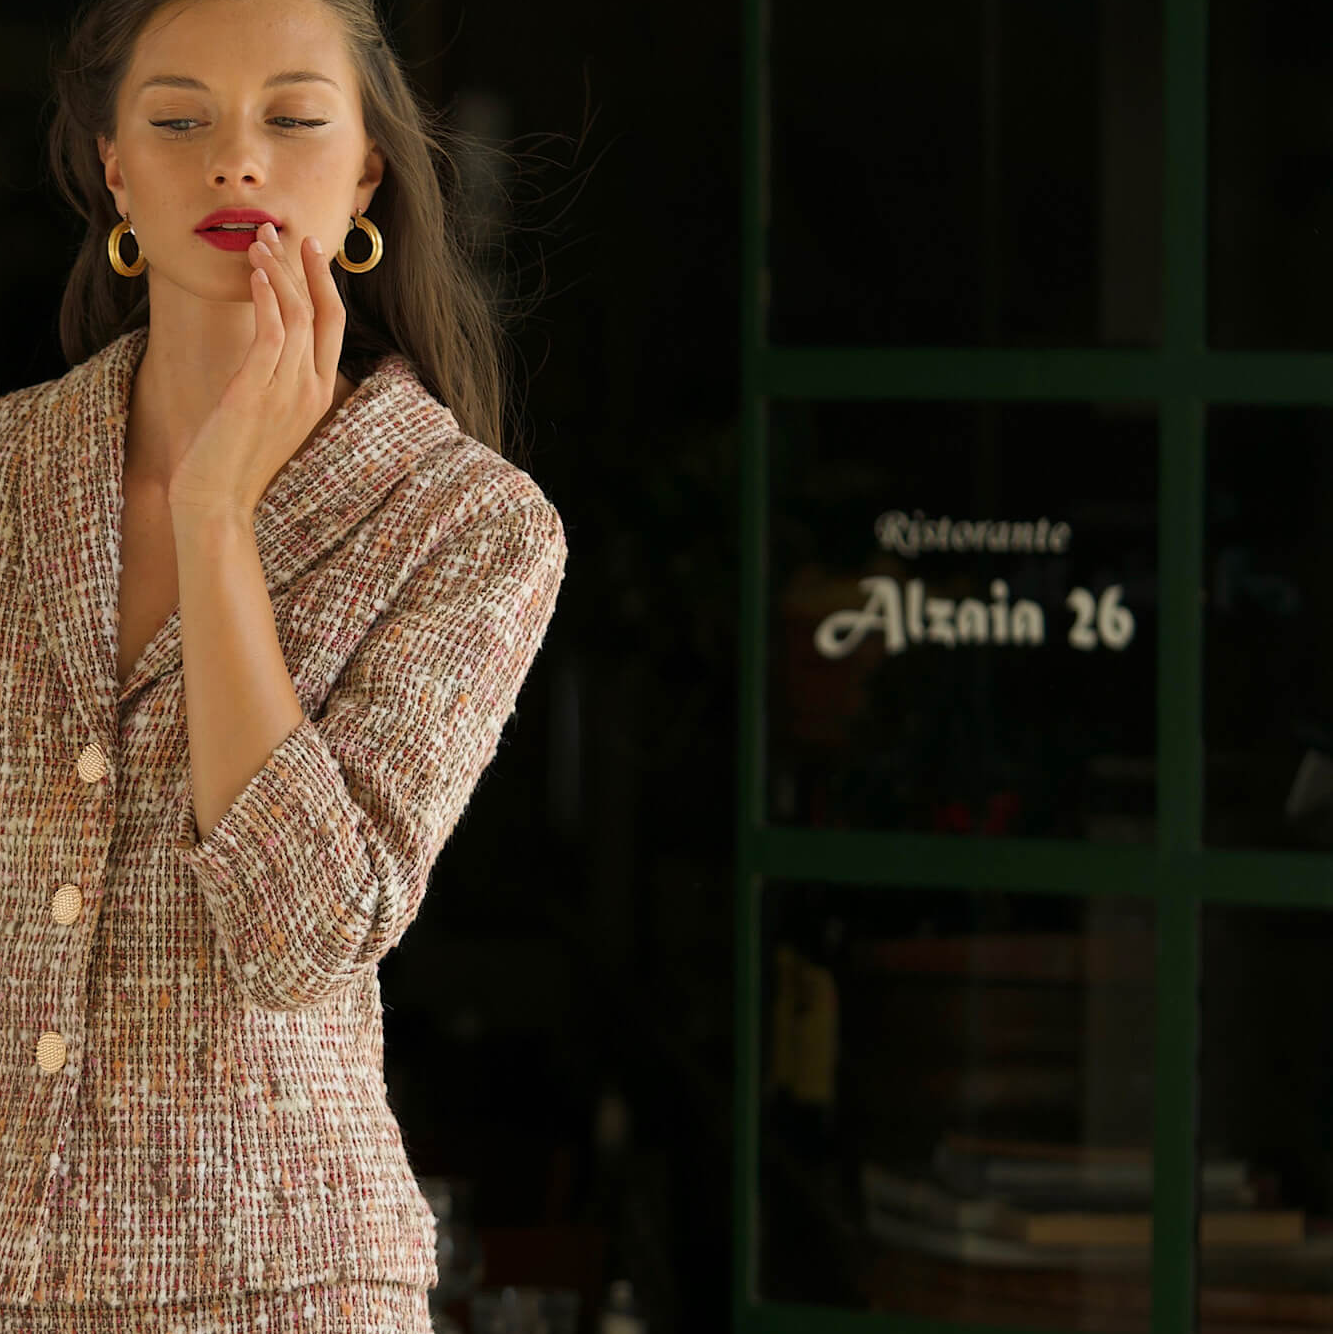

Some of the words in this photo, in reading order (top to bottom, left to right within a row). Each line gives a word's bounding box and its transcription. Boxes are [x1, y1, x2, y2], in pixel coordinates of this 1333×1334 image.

[874, 510, 1072, 556] Ristorante
[814, 575, 1046, 658] Alzaia
[1067, 584, 1136, 650] 26
